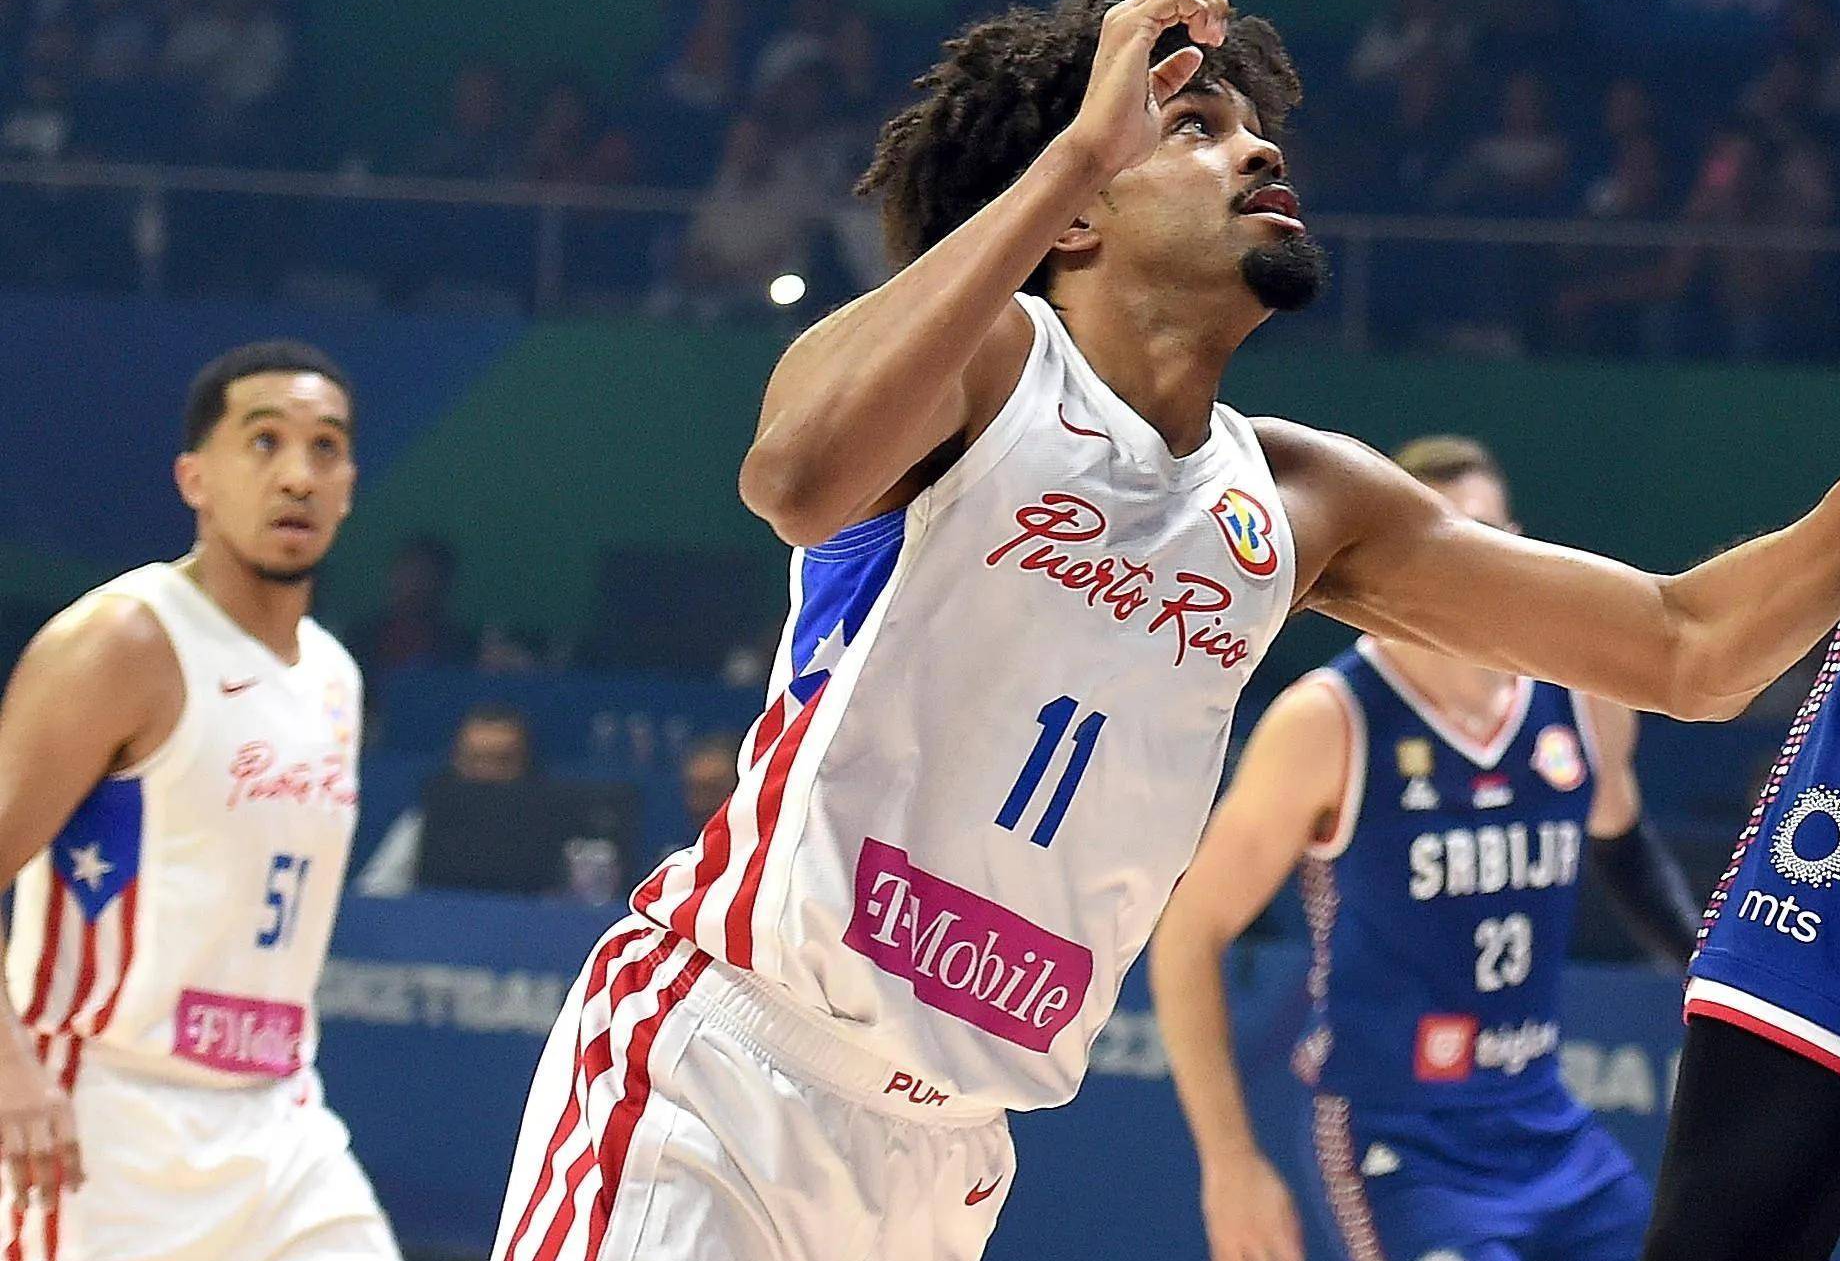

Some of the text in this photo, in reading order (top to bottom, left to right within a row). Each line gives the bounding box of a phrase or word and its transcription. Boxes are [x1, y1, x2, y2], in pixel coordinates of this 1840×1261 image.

[986, 492, 1249, 667] Puerto Rico
[993, 695, 1108, 849] 11
[1474, 912, 1533, 992] 23
[1738, 890, 1822, 943] mts
